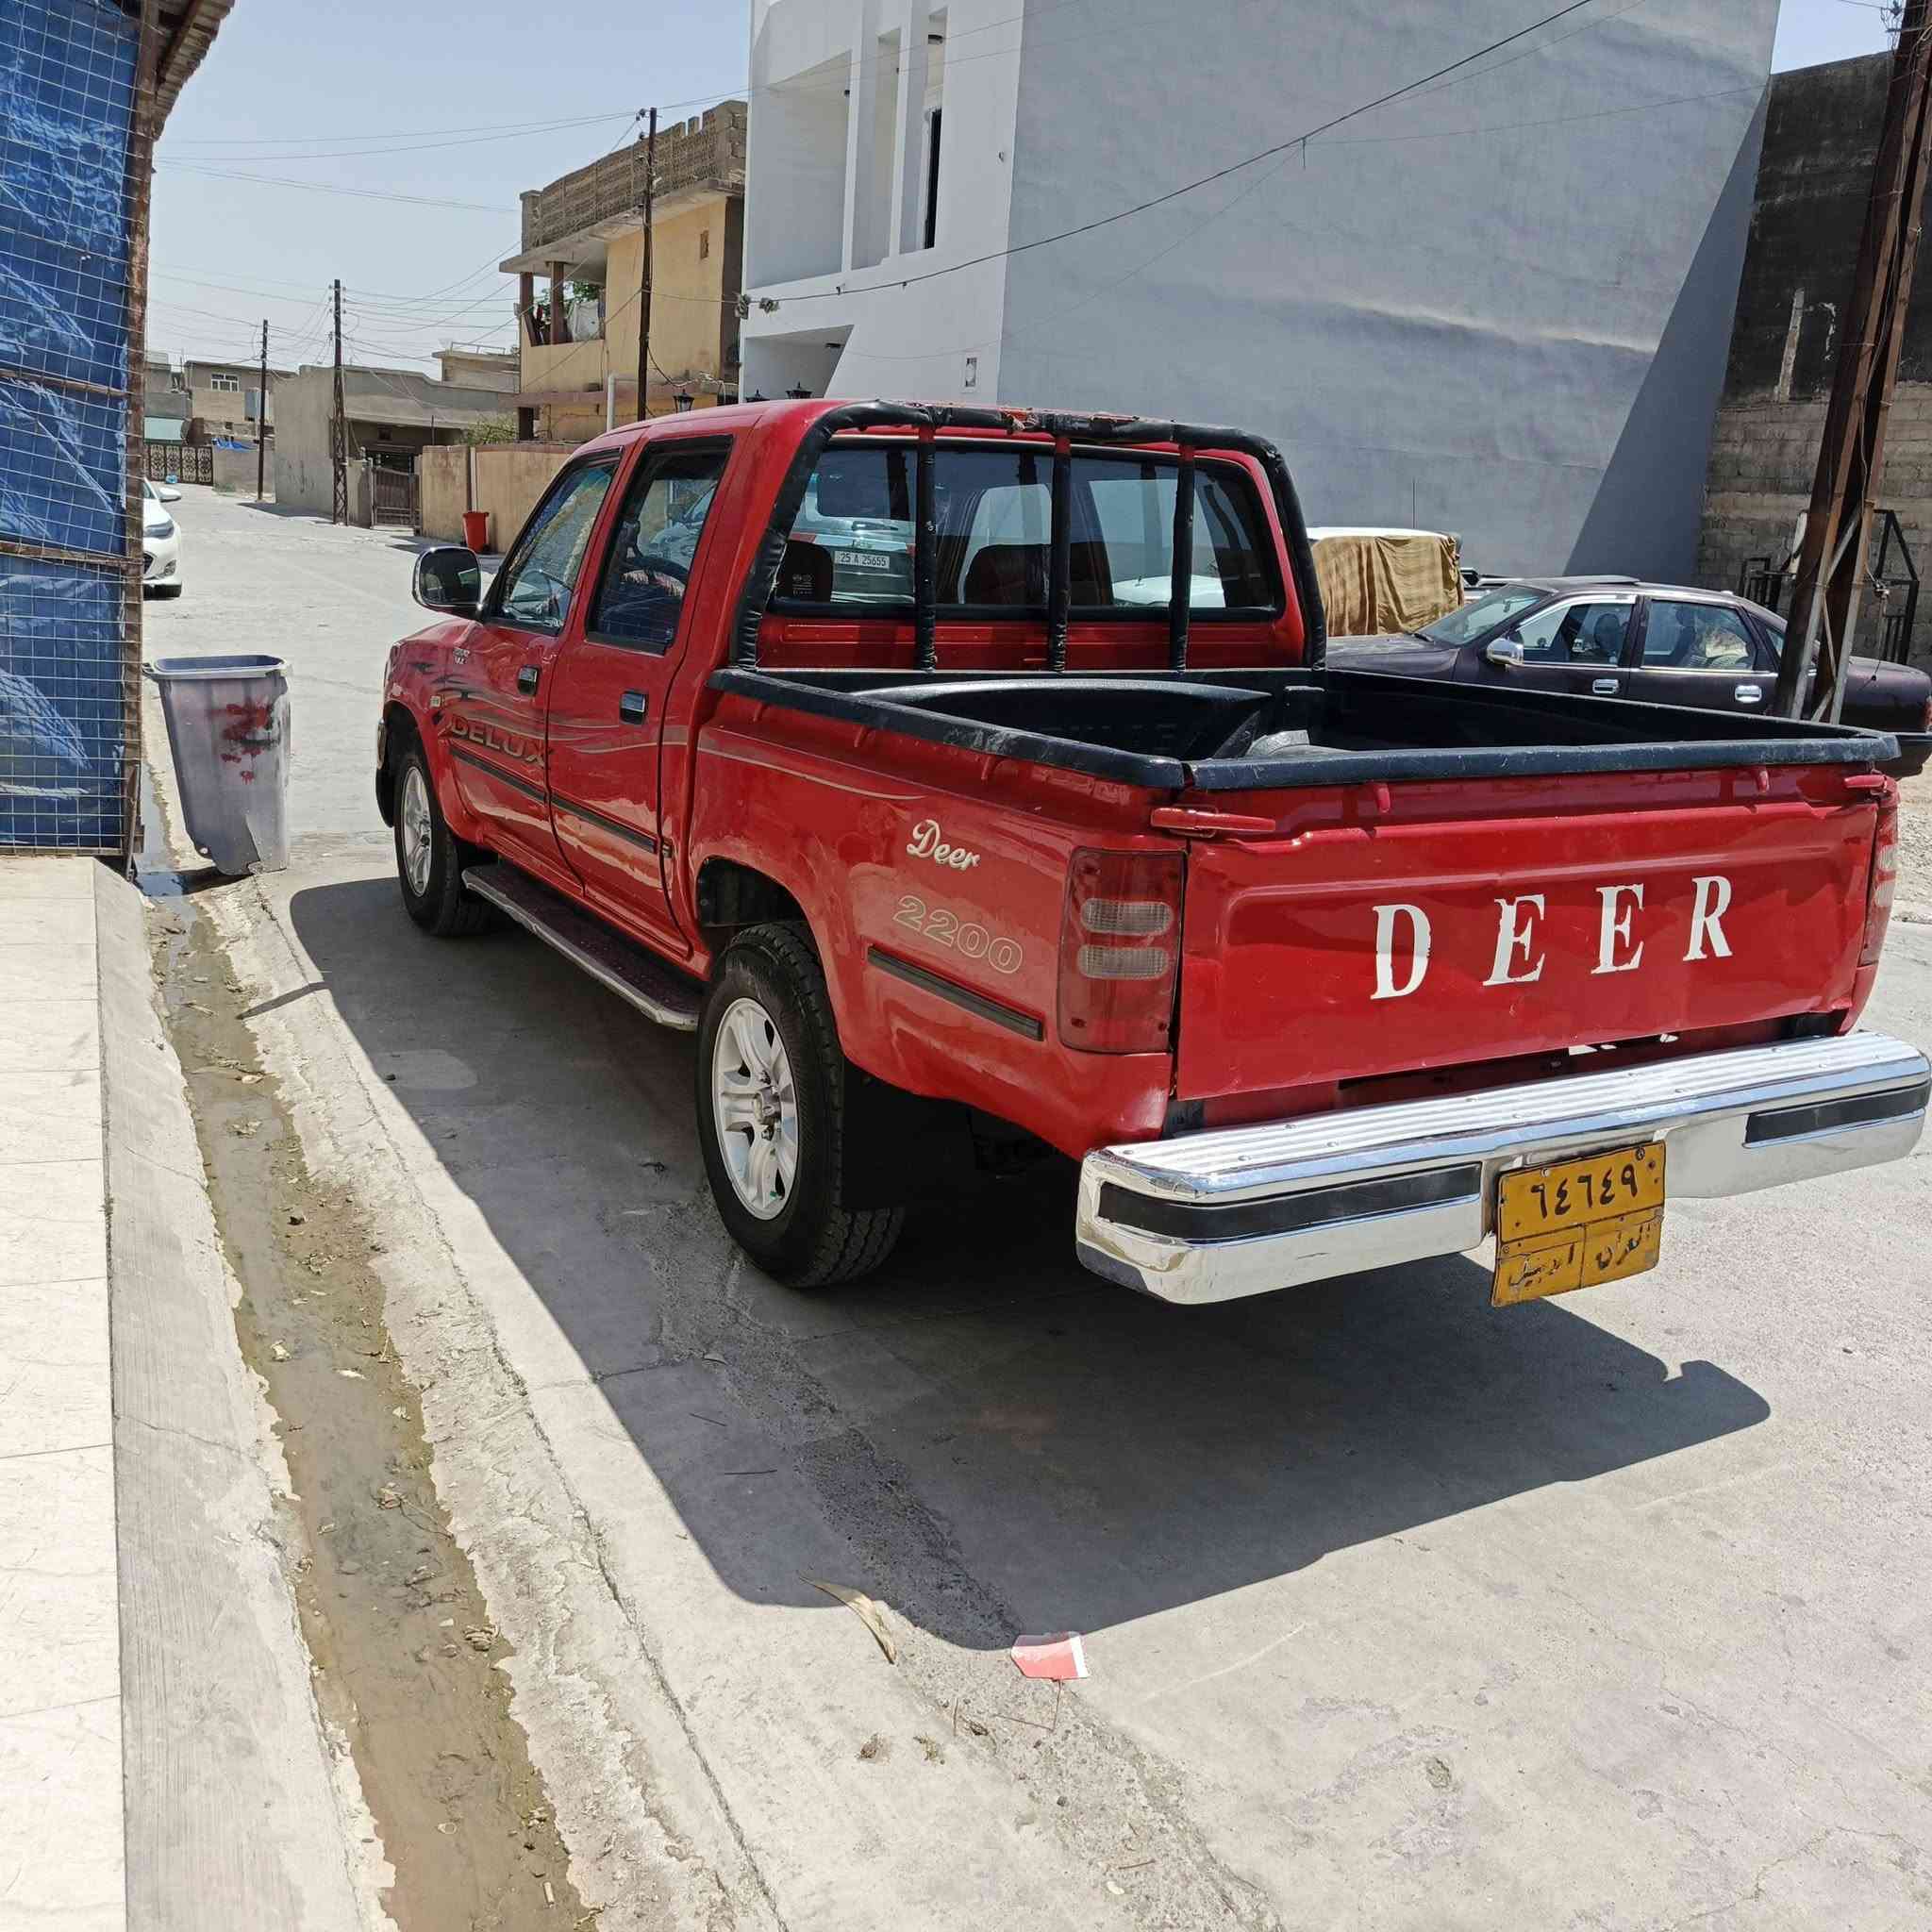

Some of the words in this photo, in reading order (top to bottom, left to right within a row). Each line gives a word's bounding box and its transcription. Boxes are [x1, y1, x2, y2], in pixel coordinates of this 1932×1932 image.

[841, 553, 851, 563] 25
[906, 819, 981, 871] Deer
[892, 894, 1024, 974] 2200
[1531, 1163, 1639, 1220] ٦٤٦٤٩
